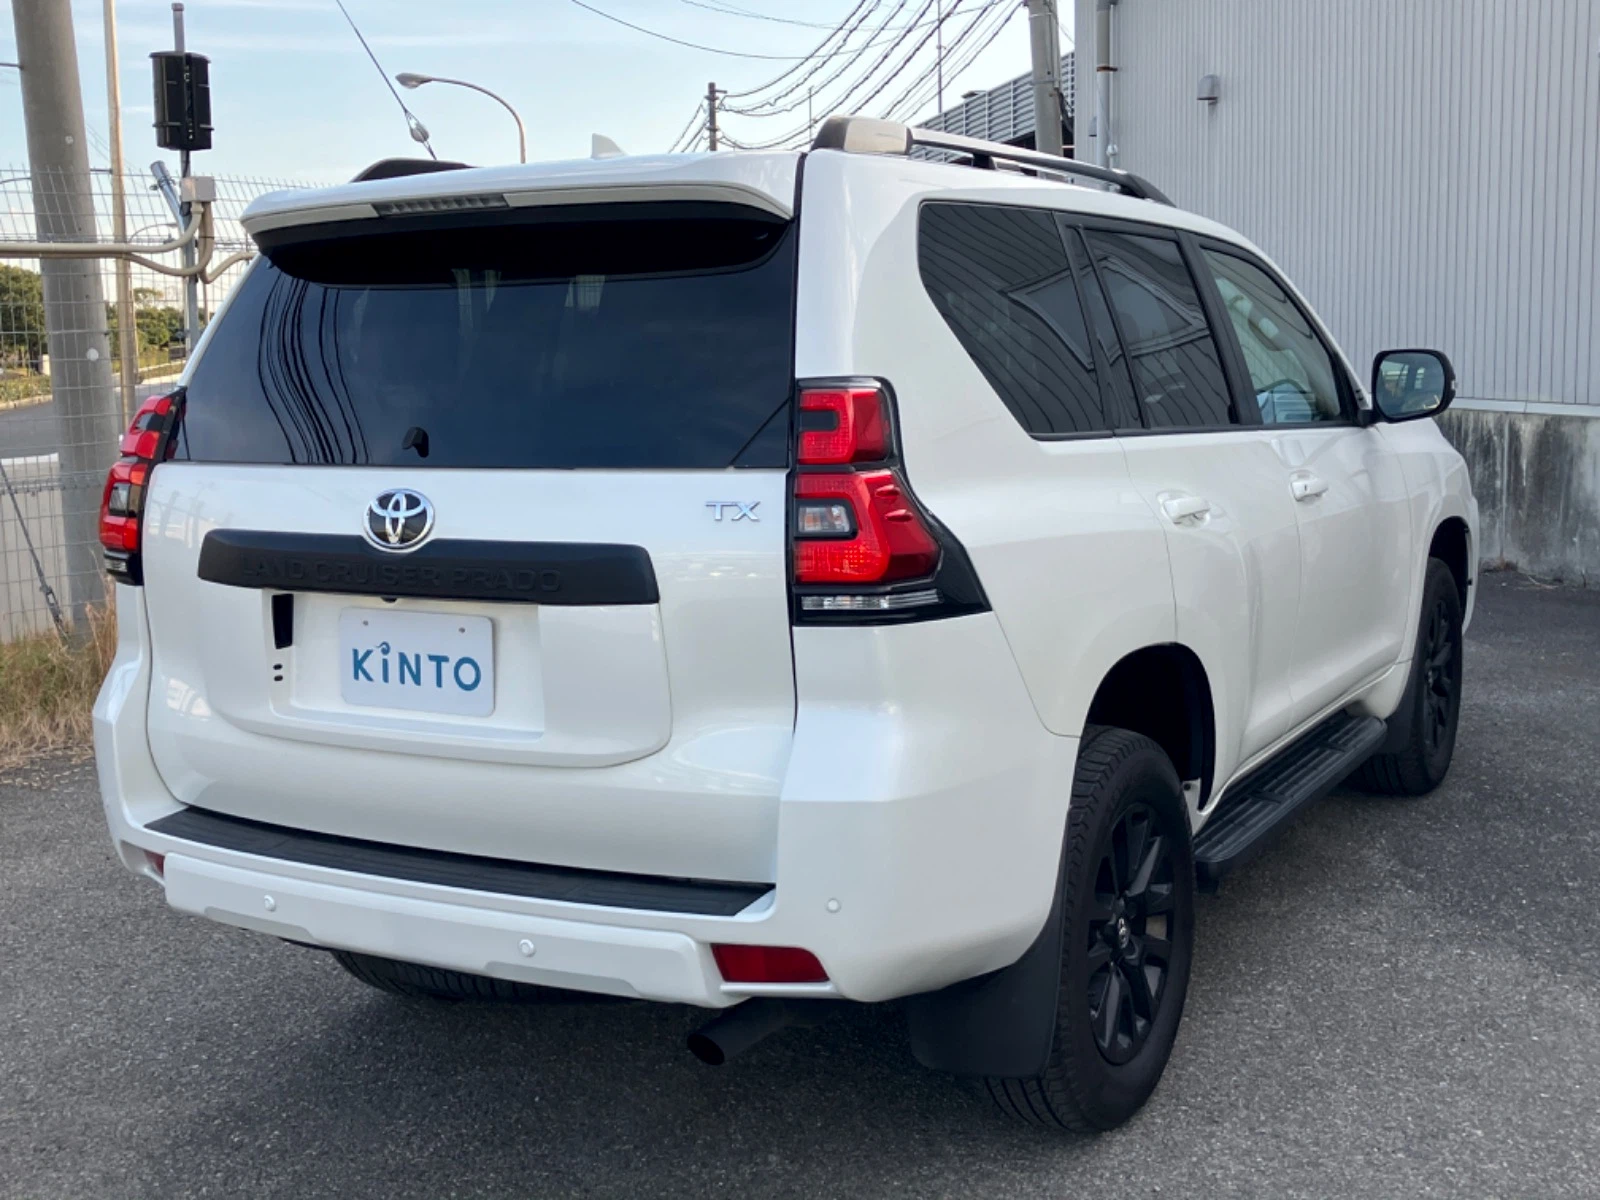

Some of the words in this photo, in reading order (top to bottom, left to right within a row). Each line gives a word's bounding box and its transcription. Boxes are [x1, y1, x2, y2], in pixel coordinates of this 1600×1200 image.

[705, 500, 761, 522] TX
[242, 556, 306, 580] LAND
[314, 560, 441, 588] CRUISER
[450, 566, 563, 592] PRADO
